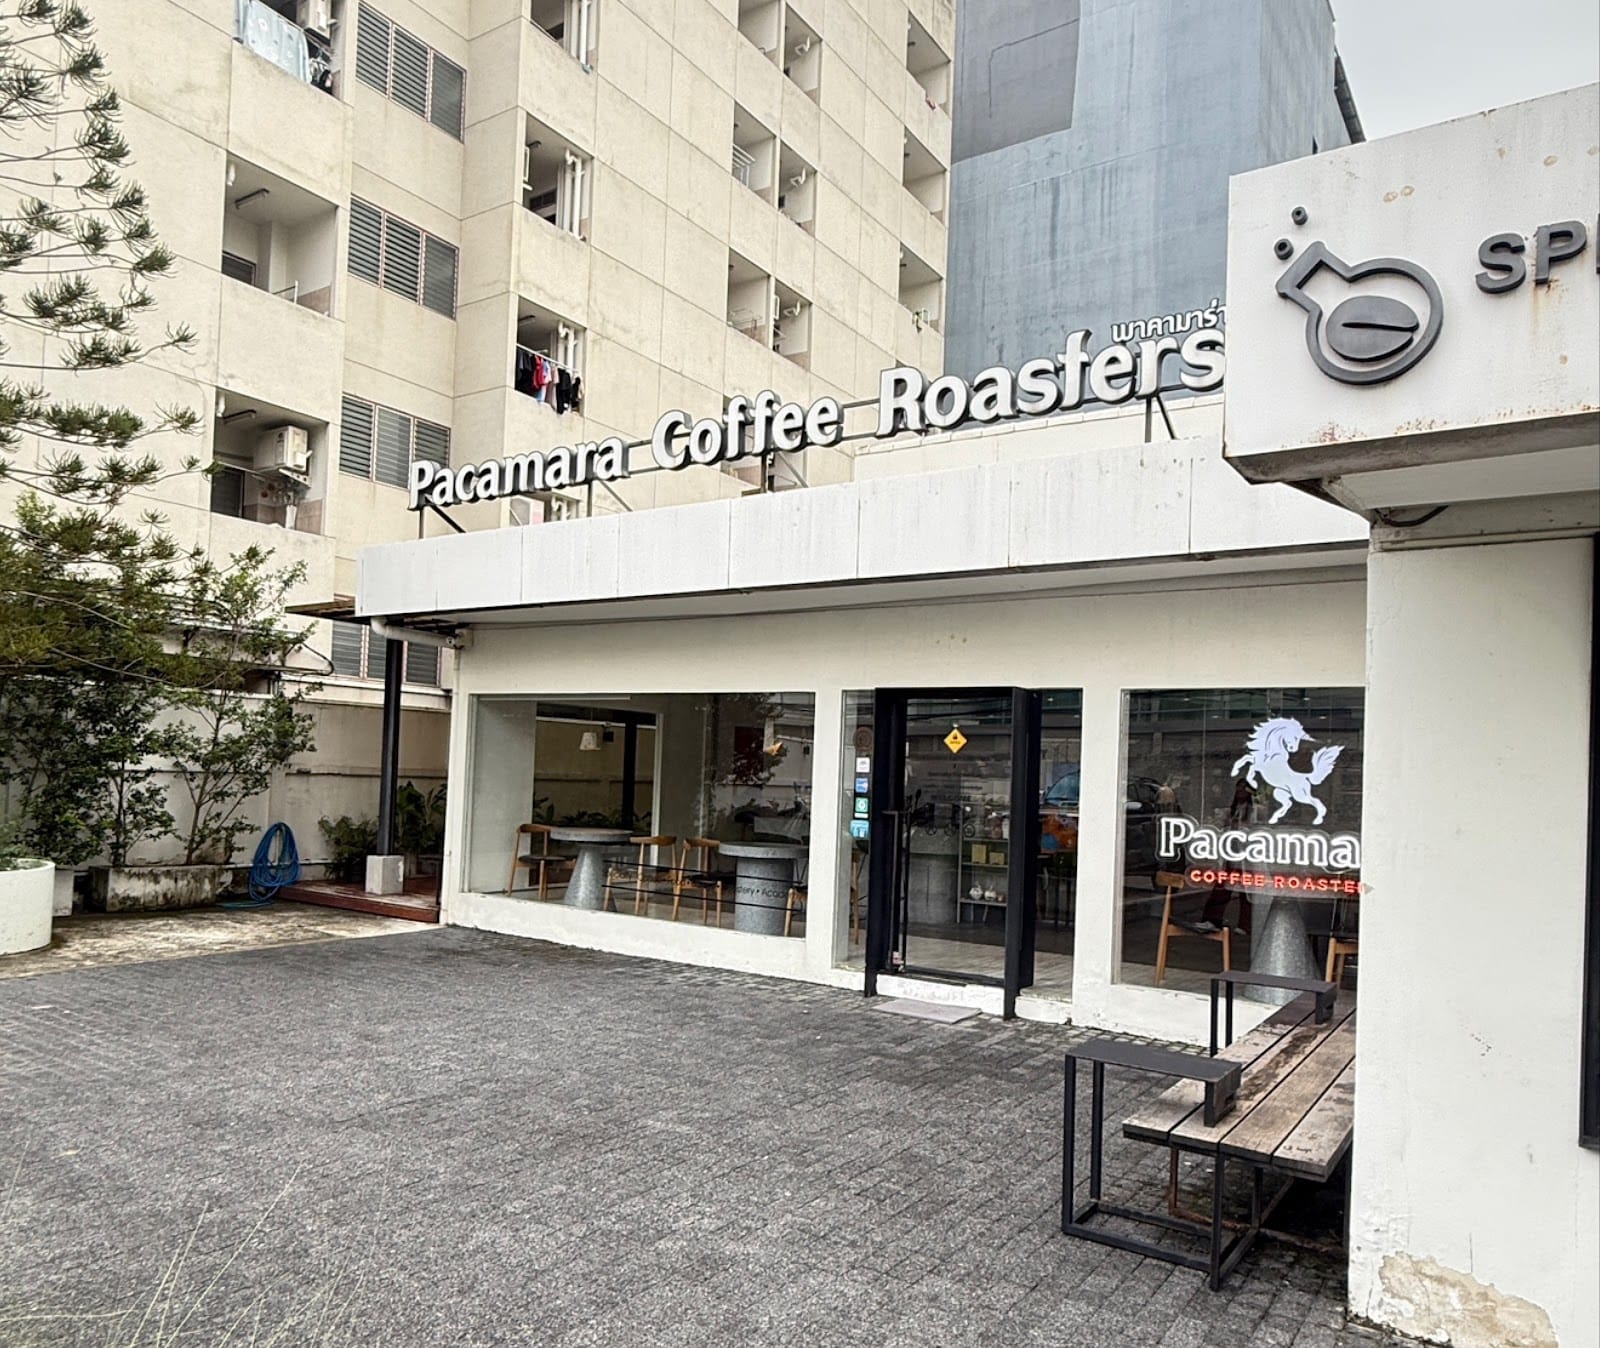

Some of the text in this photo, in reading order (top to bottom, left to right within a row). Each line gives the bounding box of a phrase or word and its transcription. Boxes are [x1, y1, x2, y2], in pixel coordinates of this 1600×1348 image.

[1475, 213, 1600, 294] SP
[408, 329, 1226, 511] Pacamara Coffee Roasters
[1159, 817, 1361, 868] Pacama
[1190, 869, 1364, 894] COFFEE ROASTE
